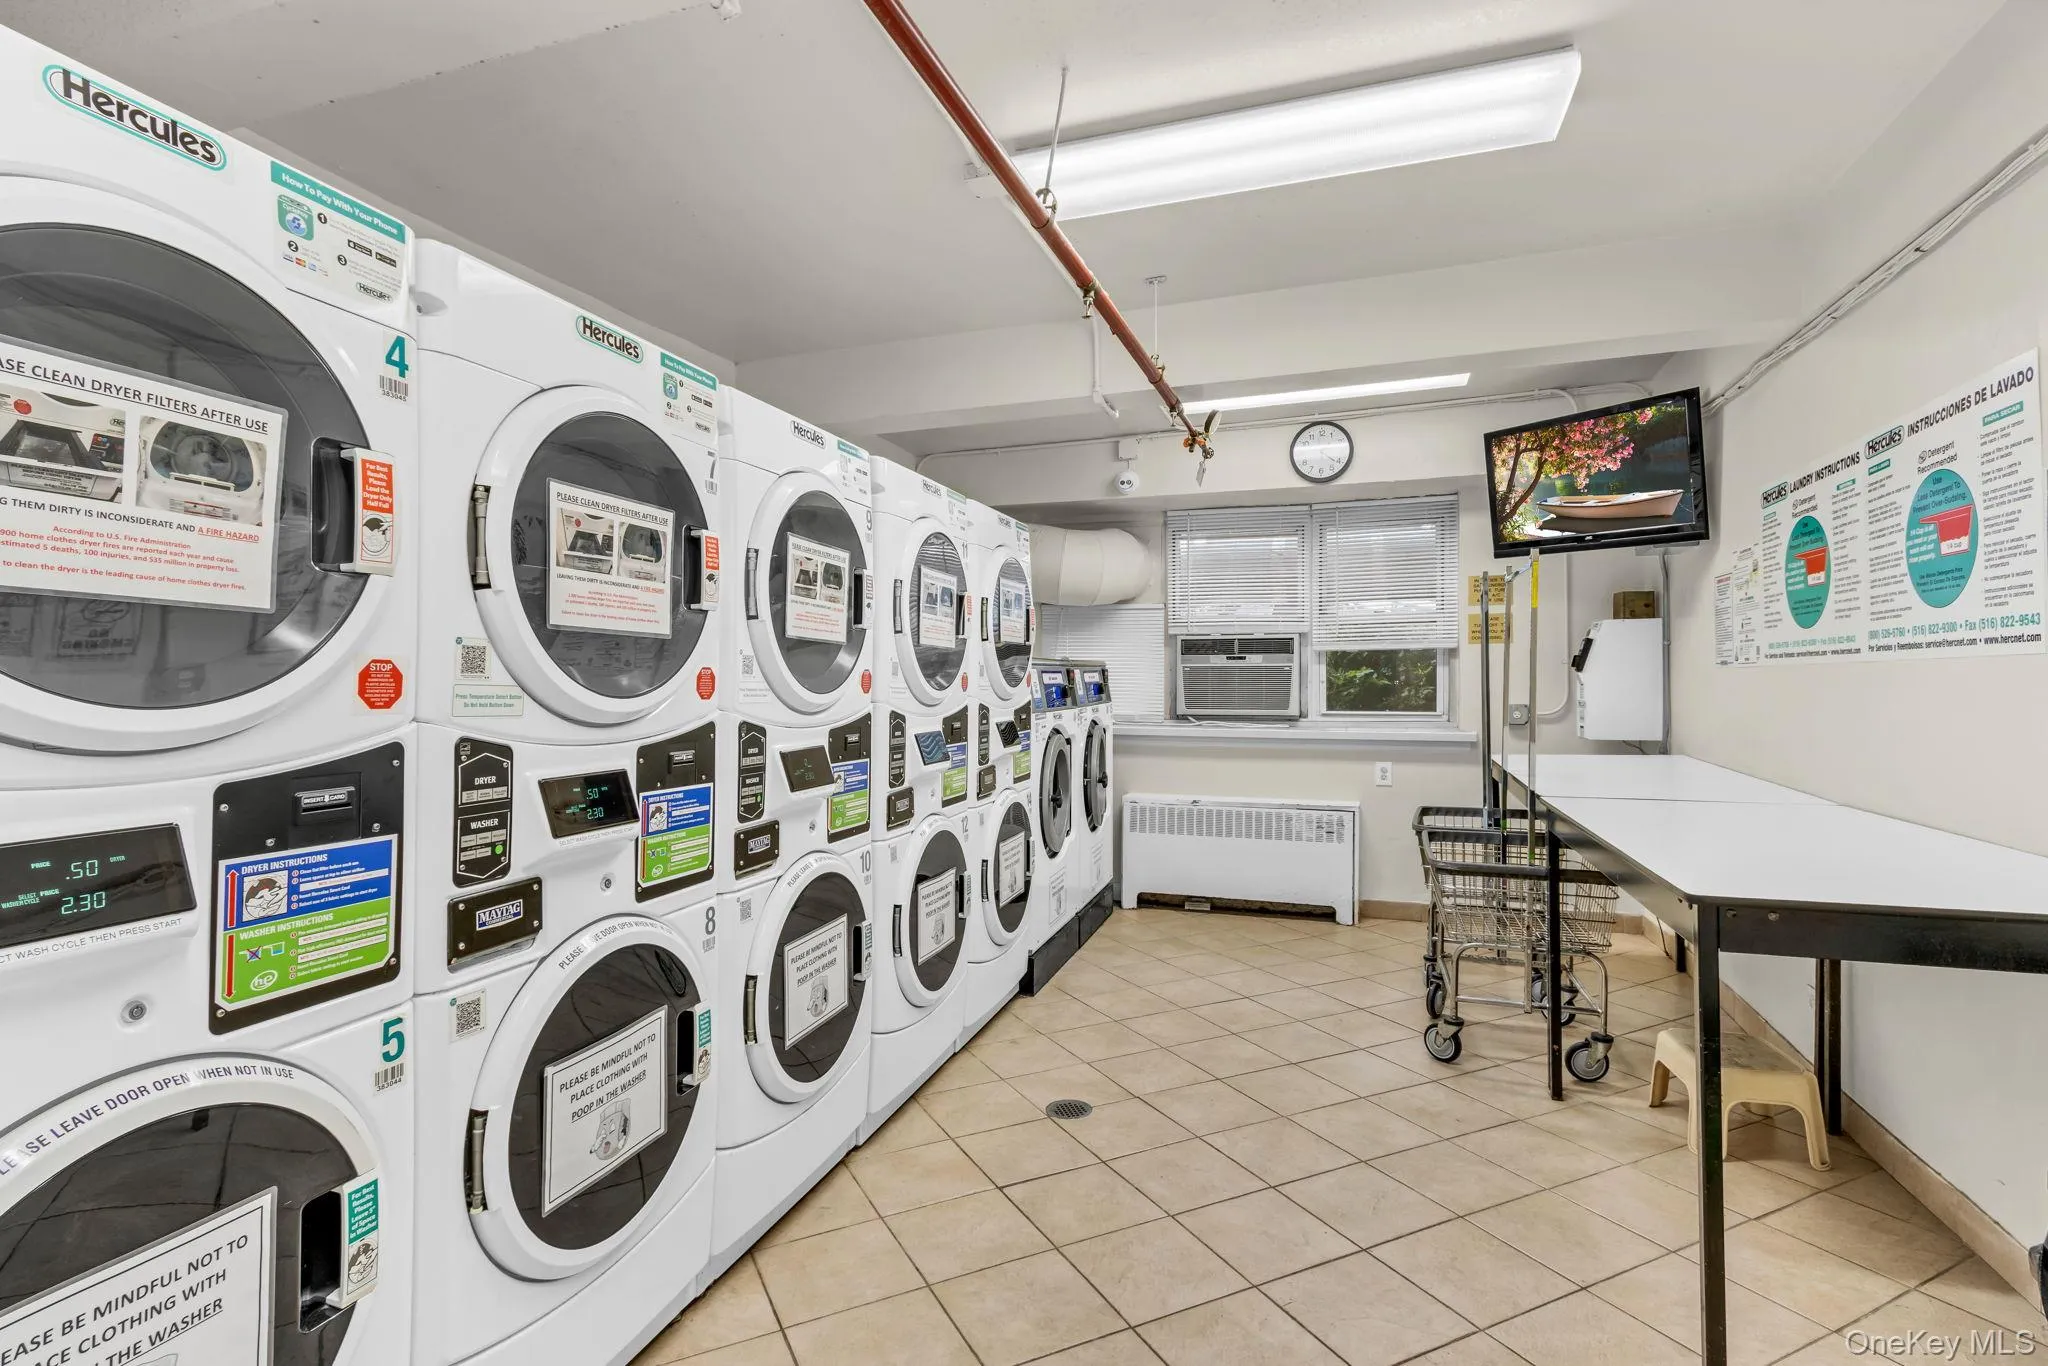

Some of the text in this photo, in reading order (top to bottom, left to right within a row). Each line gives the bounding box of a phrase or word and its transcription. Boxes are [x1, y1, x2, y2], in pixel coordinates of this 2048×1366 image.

[61, 68, 217, 164] Hercules
[282, 172, 399, 235] How To Pay With Your Phone
[582, 316, 640, 360] Hercules
[385, 335, 409, 378] 4
[32, 365, 269, 433] CLEAN DRYER FILTERS AFTER USE
[1907, 366, 2035, 437] INSTRUCCIONES DE LAVADO
[792, 420, 825, 446] Hercules
[1866, 428, 1903, 456] Hercules
[1928, 440, 1955, 458] Detergent
[1790, 452, 1860, 493] LAUNDRY INSTRUCTIONS
[1917, 453, 1957, 475] Recommended
[12, 498, 45, 511] THEM
[49, 503, 81, 517] DIRTY
[84, 508, 94, 518] IS
[96, 510, 174, 530] INCONSIDERATE
[176, 520, 196, 532] AND
[206, 526, 224, 538] FIRE
[225, 530, 260, 542] HAZARD
[556, 491, 669, 525] PLEASE CLEAN DRYER FILTERS AFTER USE
[866, 509, 873, 531] 9
[19, 531, 234, 564] home clothes dryer fires are reported each year and cause
[53, 526, 191, 549] According to U.S. Fire Administration
[50, 545, 81, 556] deaths,
[84, 549, 98, 557] 100
[100, 551, 131, 563] injuries,
[164, 558, 187, 567] million
[197, 562, 224, 573] property
[3, 560, 13, 568] to
[15, 560, 39, 570] clean
[41, 562, 55, 571] the
[57, 564, 80, 576] dryer
[90, 567, 104, 576] the
[105, 569, 134, 580] leading
[136, 572, 156, 581] cause
[166, 576, 185, 584] home
[187, 577, 211, 587] clothes
[213, 581, 229, 590] dryer
[1965, 620, 1977, 631] Fax
[1978, 617, 1998, 632] (516)
[2000, 612, 2041, 629] 822-9543
[1983, 632, 2041, 645] www.hercnet.com
[370, 663, 393, 672] STOP
[474, 776, 497, 785] DRYER
[470, 818, 499, 829] WASHER
[587, 807, 604, 819] 2.30
[31, 860, 99, 880] PRICE .50
[241, 863, 269, 875] DRYER
[270, 854, 328, 870] INSTRUCTIONS
[860, 850, 871, 873] 10
[18, 888, 60, 901] SELECT PRICE
[61, 891, 106, 915] 2.30
[240, 913, 333, 941] WASHER INSTRUCTIONS
[478, 903, 521, 924] MAYTAG
[705, 906, 716, 935] 8
[16, 945, 49, 960] WASH
[51, 938, 86, 953] CYCLE
[89, 931, 117, 944] THEN
[119, 924, 151, 938] PRESS
[153, 917, 183, 931] START
[558, 921, 634, 970] PLEASE DOOR OPEN
[381, 1017, 406, 1063] 5
[560, 1033, 656, 1093] PLEASE BE MINDFUL NOT TO
[376, 1077, 403, 1092] 383044
[570, 1052, 648, 1104] PLACE CLOTHING WITH
[50, 1065, 294, 1139] LEAVE DOOR OPEN WHEN NOT IN USE
[571, 1069, 647, 1121] POOP IN THE WASHER
[61, 1313, 87, 1337] BE
[93, 1279, 182, 1321] MINDFUL
[187, 1248, 223, 1276] NOT
[227, 1234, 249, 1257] TO
[78, 1269, 228, 1355] CLOTHING WITH
[105, 1297, 223, 1366] THE WASHER
